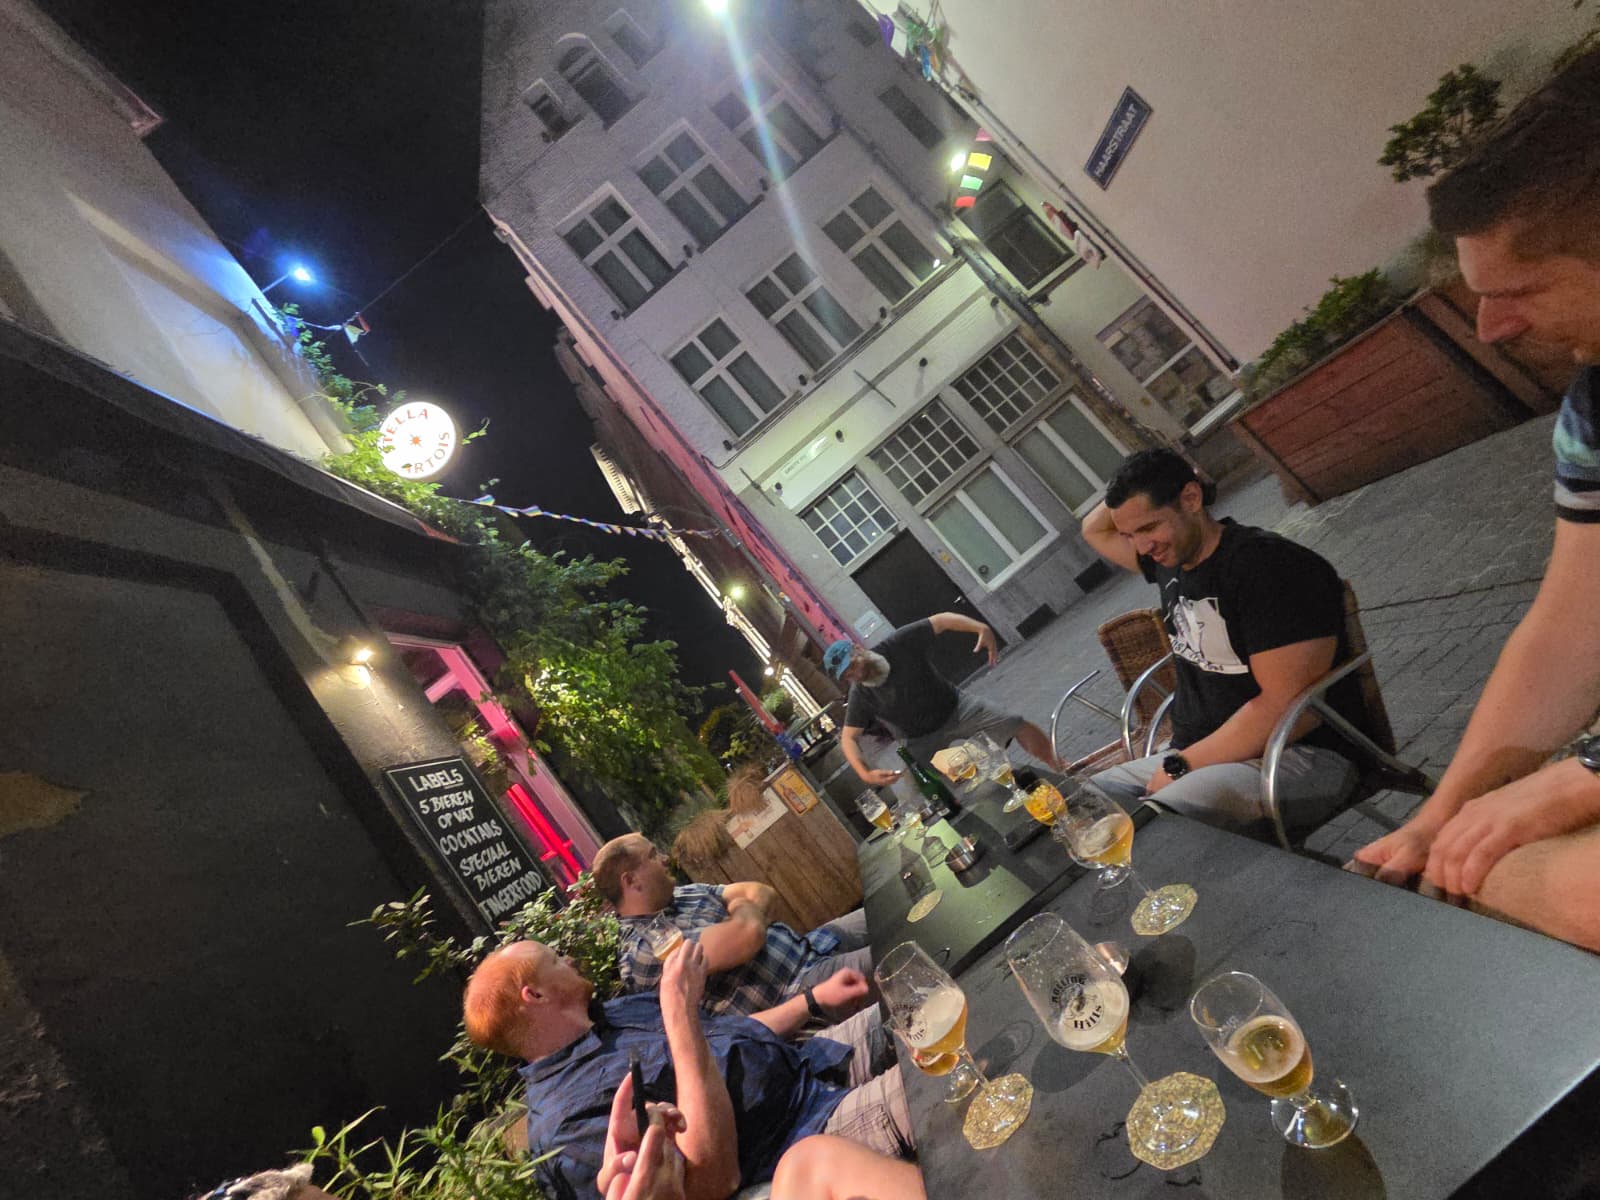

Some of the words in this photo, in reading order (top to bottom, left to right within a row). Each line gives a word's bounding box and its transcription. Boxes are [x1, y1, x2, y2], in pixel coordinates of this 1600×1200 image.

[1093, 102, 1139, 177] HAARSTRAAT
[383, 408, 428, 452] TELLA
[419, 799, 430, 815] 5
[429, 790, 475, 813] BIEREN
[437, 812, 453, 829] OP
[453, 806, 475, 824] VAT
[439, 819, 503, 856] COCKTAILS
[459, 840, 512, 877] SPECIAAL
[473, 857, 522, 893] BIEREN
[478, 870, 543, 923] FINGERFOOD
